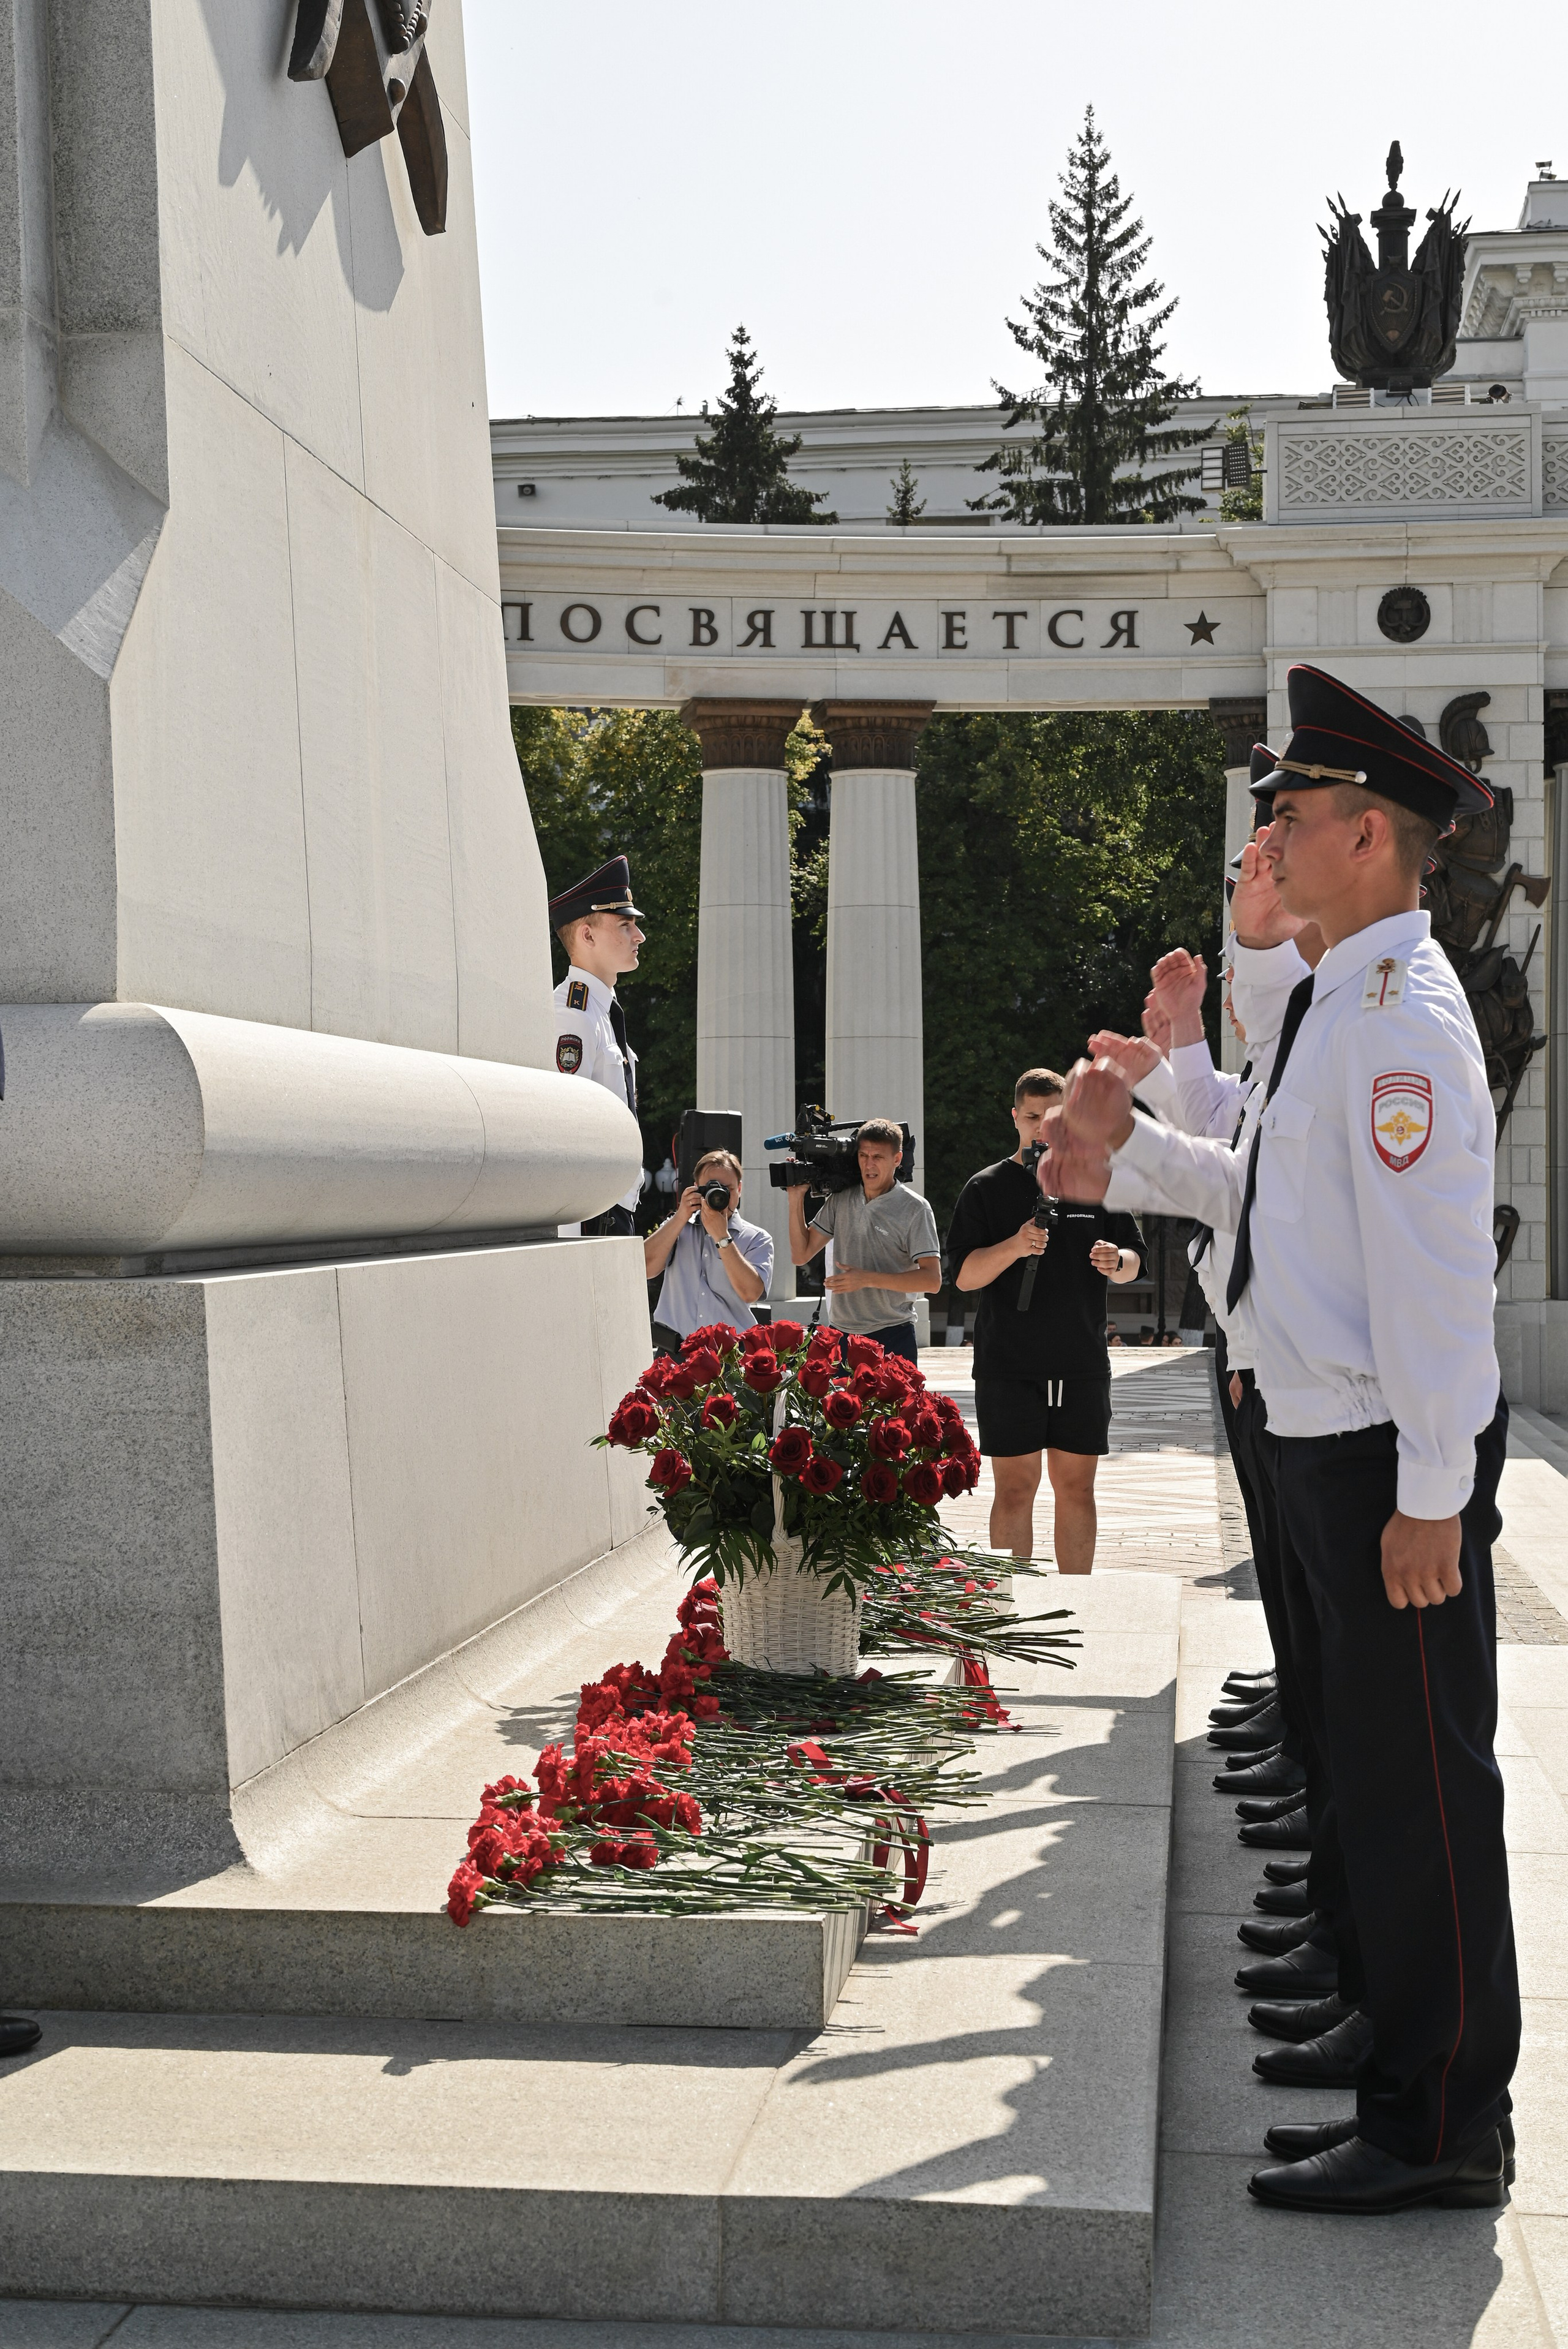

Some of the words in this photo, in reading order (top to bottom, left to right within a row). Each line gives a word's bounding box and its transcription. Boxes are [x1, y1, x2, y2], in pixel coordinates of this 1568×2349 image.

[502, 602, 1140, 653] ПОСВЯЩАЕТСЯ
[1377, 1075, 1427, 1089] ПОЛИЦИЯ
[1379, 1096, 1425, 1113] РОССИЯ
[1389, 1155, 1409, 1167] МВД
